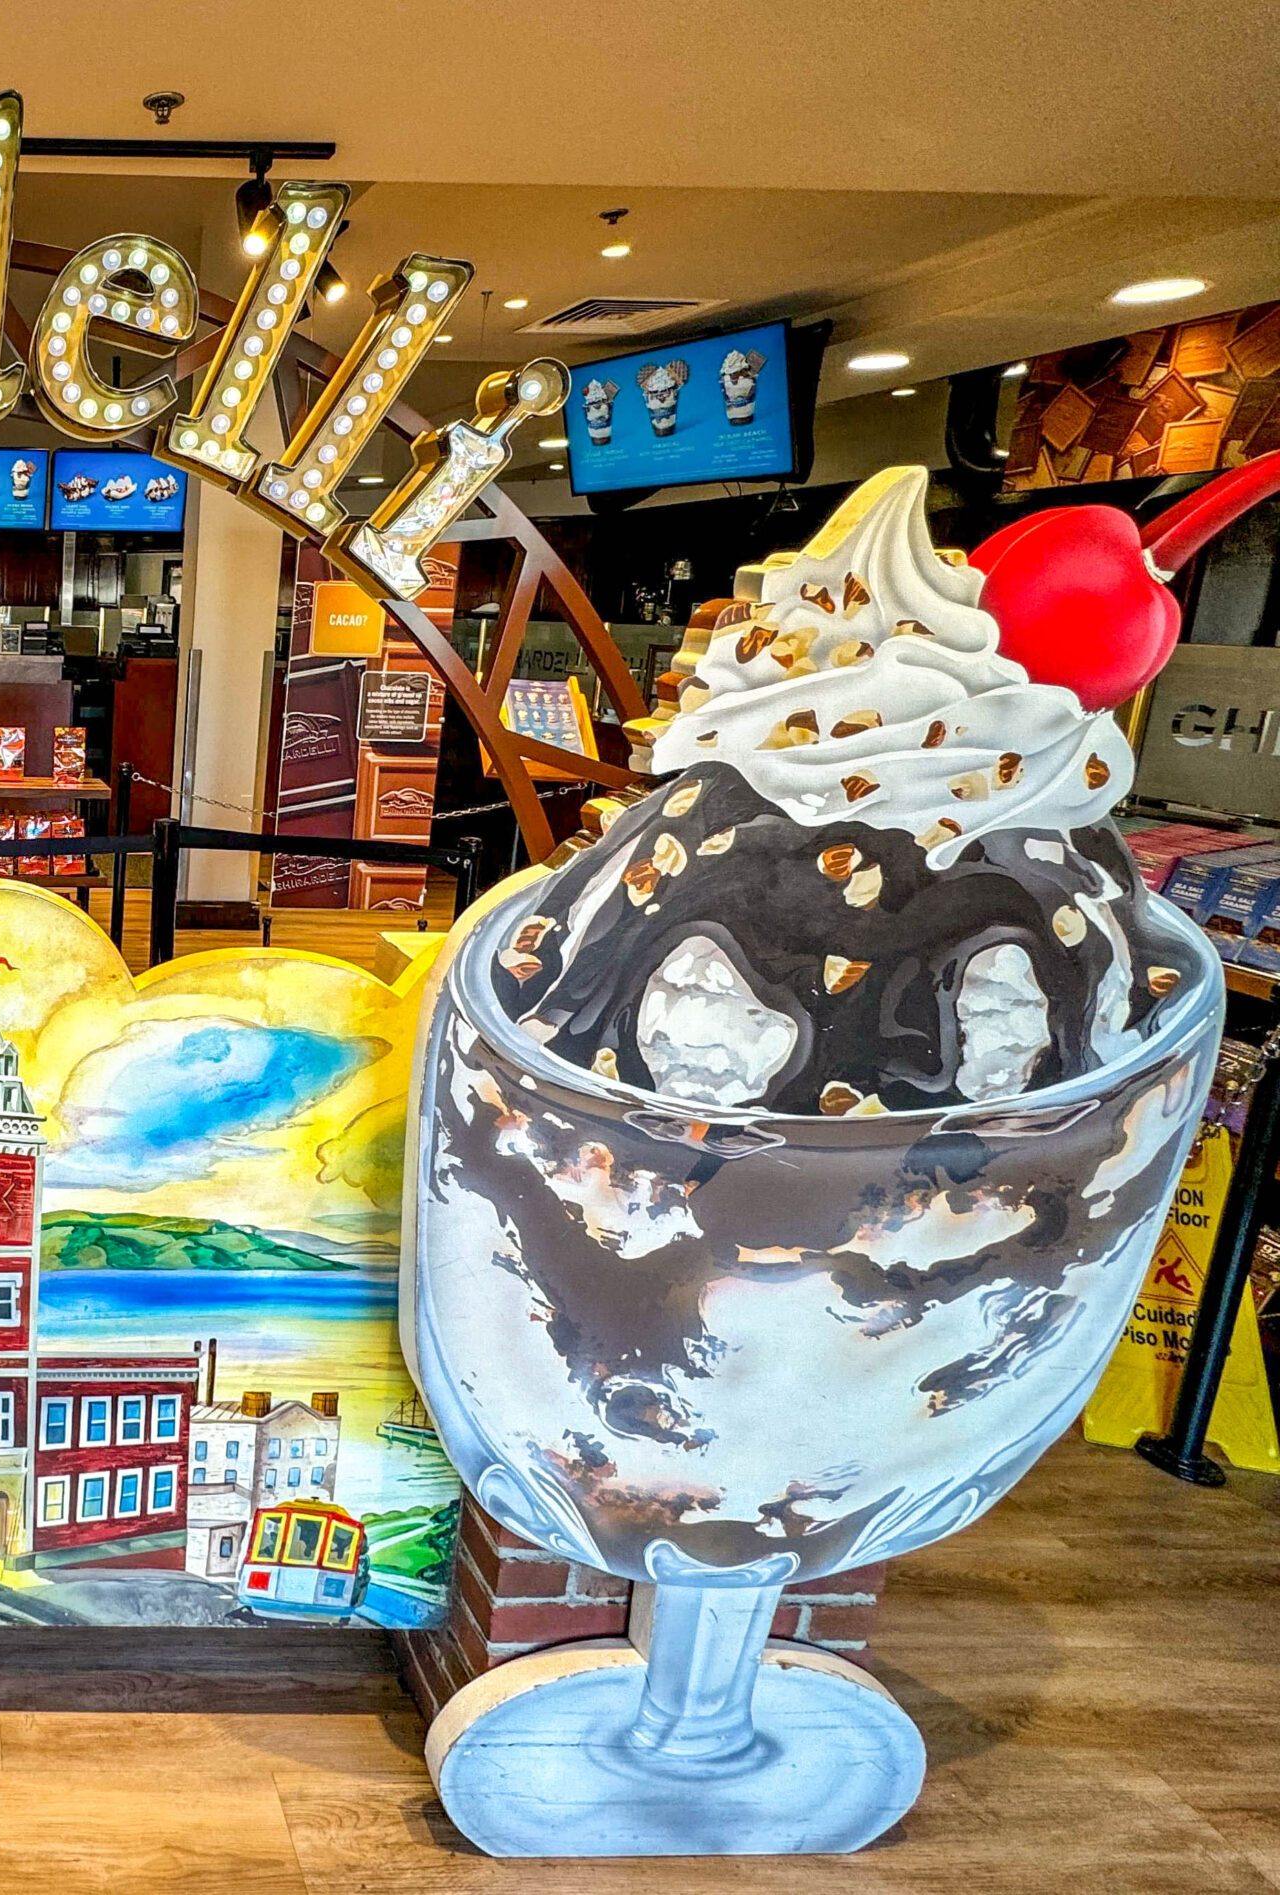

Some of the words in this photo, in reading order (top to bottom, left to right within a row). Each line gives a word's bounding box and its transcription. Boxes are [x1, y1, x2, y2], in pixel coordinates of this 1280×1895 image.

[329, 614, 368, 627] CACAO?
[1171, 888, 1203, 900] CARAMEL
[1174, 882, 1187, 890] SEA
[1188, 886, 1205, 894] SALT
[1219, 899, 1253, 912] CARAMEL
[1223, 894, 1237, 902] SEA
[1238, 897, 1256, 905] SALT
